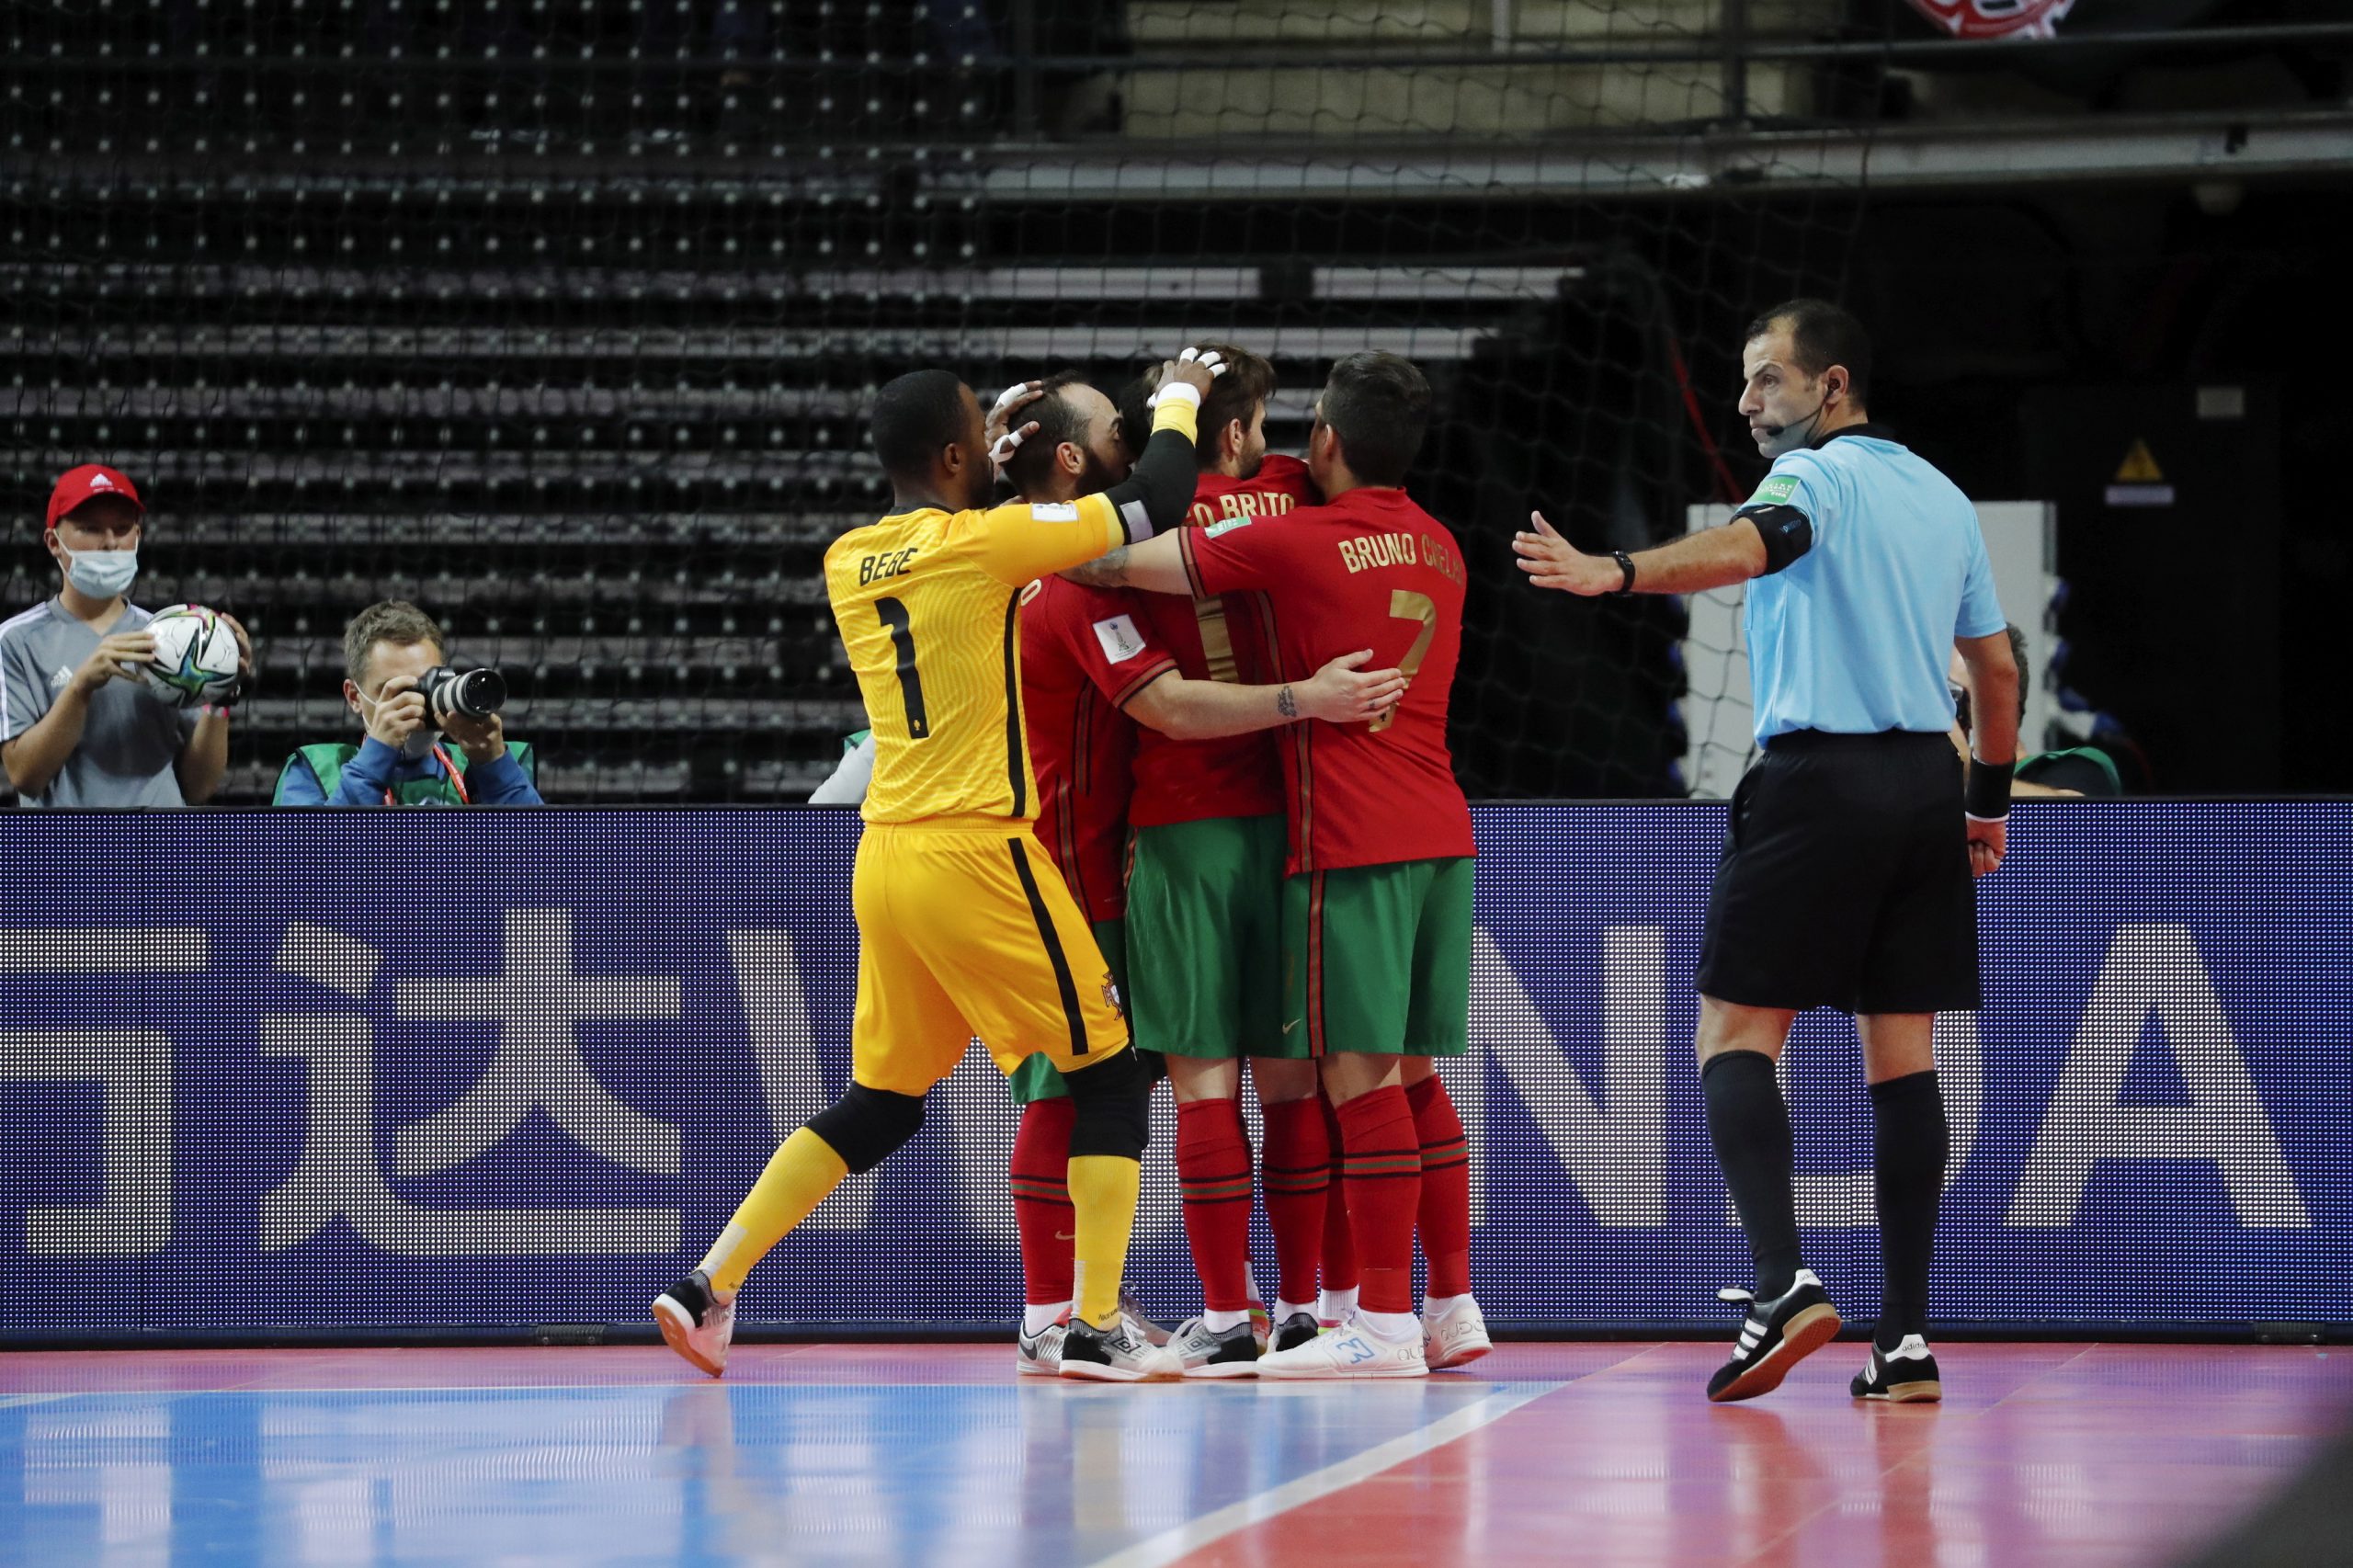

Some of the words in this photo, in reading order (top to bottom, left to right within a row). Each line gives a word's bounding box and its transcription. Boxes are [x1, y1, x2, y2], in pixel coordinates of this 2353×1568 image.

[1220, 492, 1295, 520] BRITO
[859, 548, 918, 586] BEBE
[1338, 533, 1417, 574] BRUNO
[874, 597, 929, 739] 1
[1369, 589, 1437, 733] 7
[1902, 1343, 1926, 1352] adida
